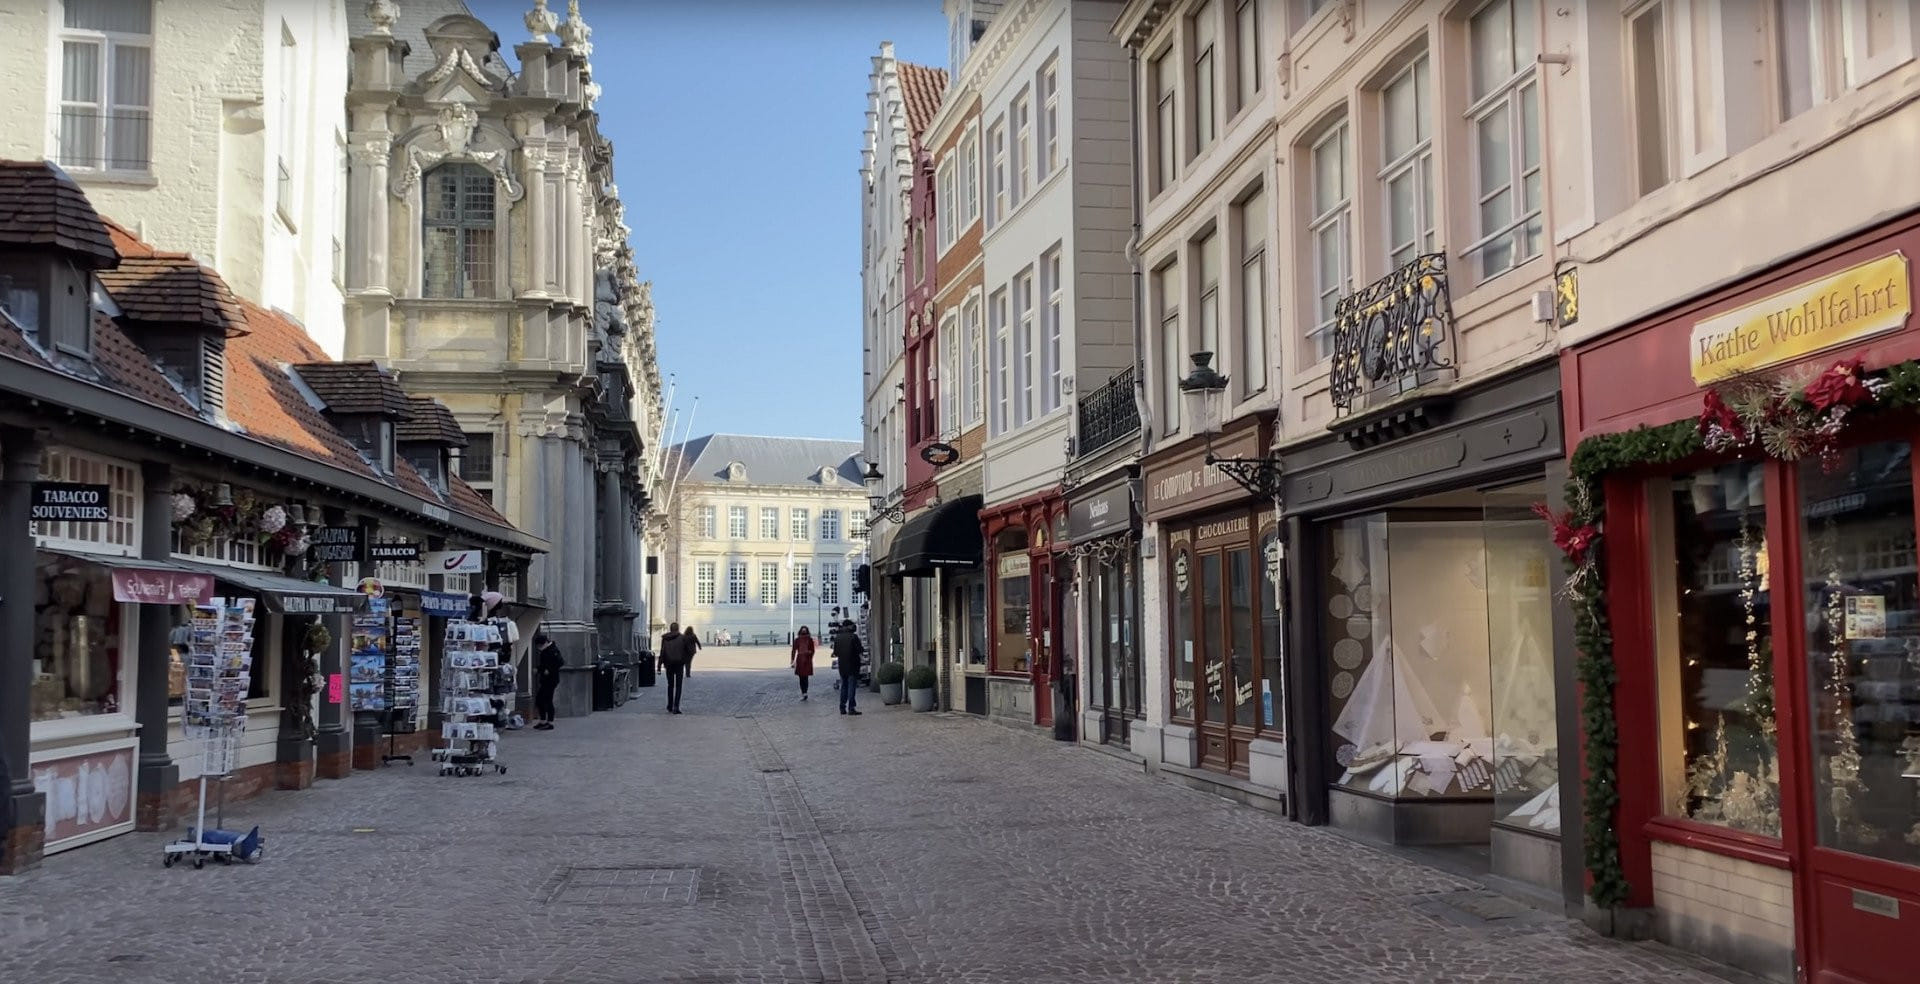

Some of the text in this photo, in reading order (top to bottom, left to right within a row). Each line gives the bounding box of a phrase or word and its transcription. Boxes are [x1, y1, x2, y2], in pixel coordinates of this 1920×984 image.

[1700, 278, 1898, 367] Käthe Wohlfahrt
[1160, 469, 1193, 501] COMPTOIR
[42, 490, 99, 504] TABACCO
[32, 505, 108, 519] SOUVENIERS
[1198, 516, 1249, 540] CHOCOLATERIE
[371, 547, 416, 556] TABACCO
